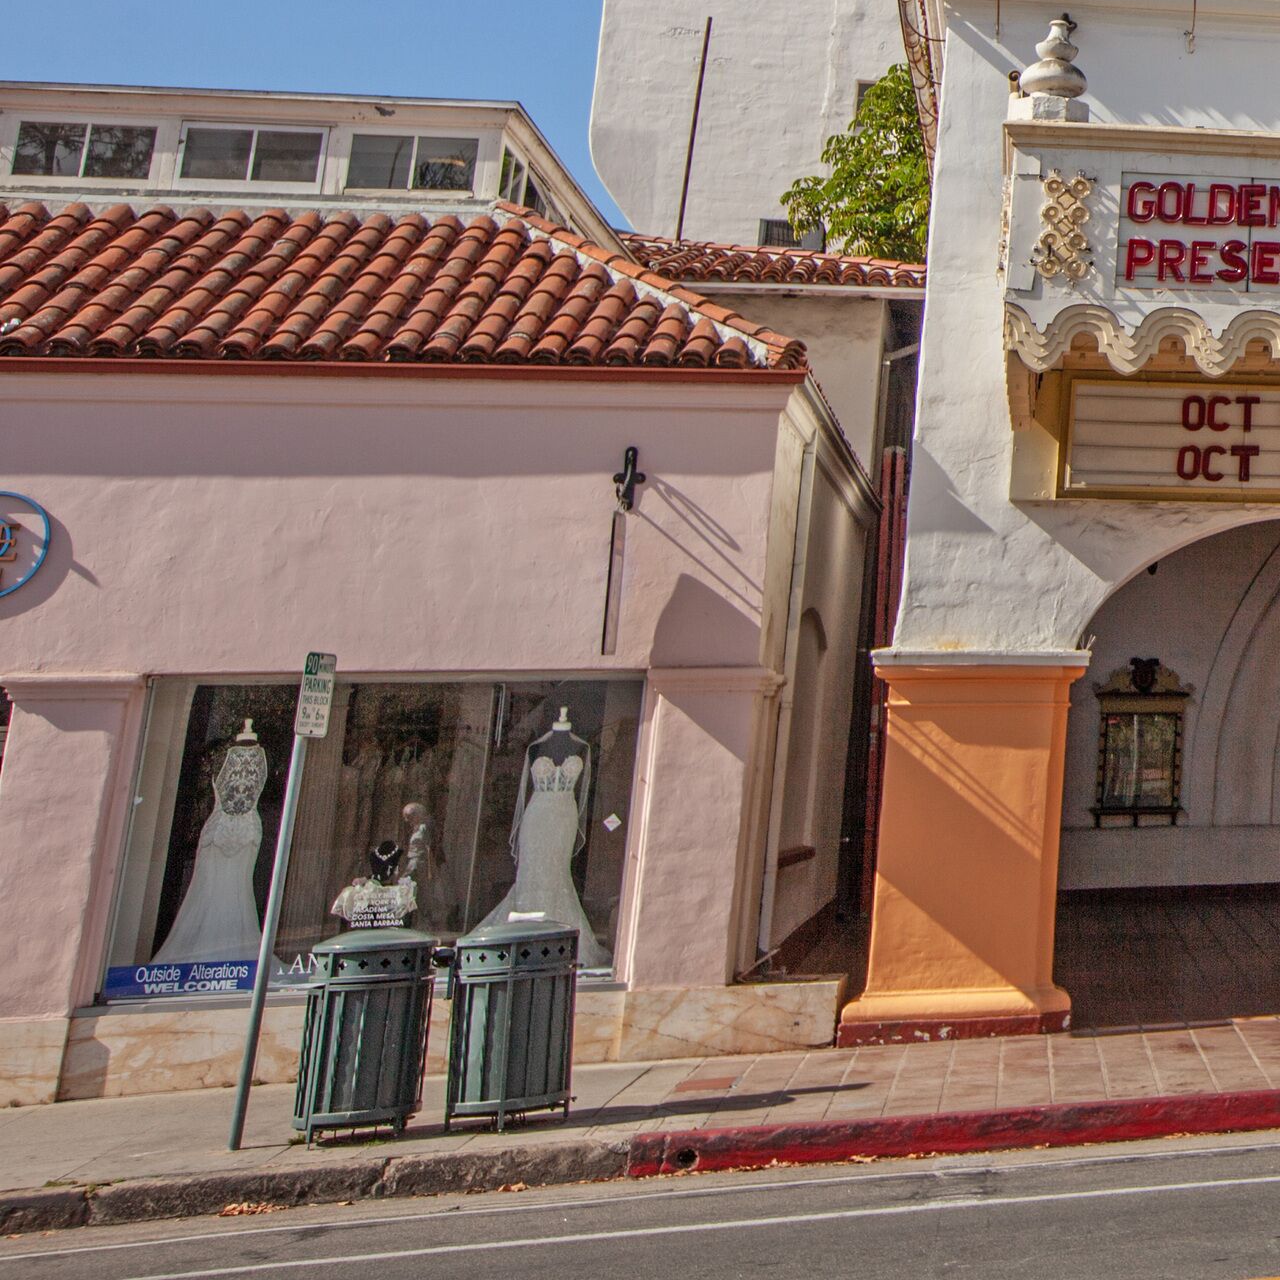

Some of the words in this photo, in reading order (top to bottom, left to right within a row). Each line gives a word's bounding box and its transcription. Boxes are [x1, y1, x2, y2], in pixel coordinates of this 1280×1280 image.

[1182, 395, 1260, 433] OCT
[1176, 445, 1260, 482] OCT
[306, 655, 319, 674] 90
[304, 678, 331, 694] PARKING
[303, 695, 313, 705] THIS
[314, 696, 329, 705] BLOCK
[373, 919, 404, 927] BARBARA
[135, 966, 181, 983] Outside
[189, 963, 249, 981] Alterations
[143, 979, 238, 994] WELCOME
